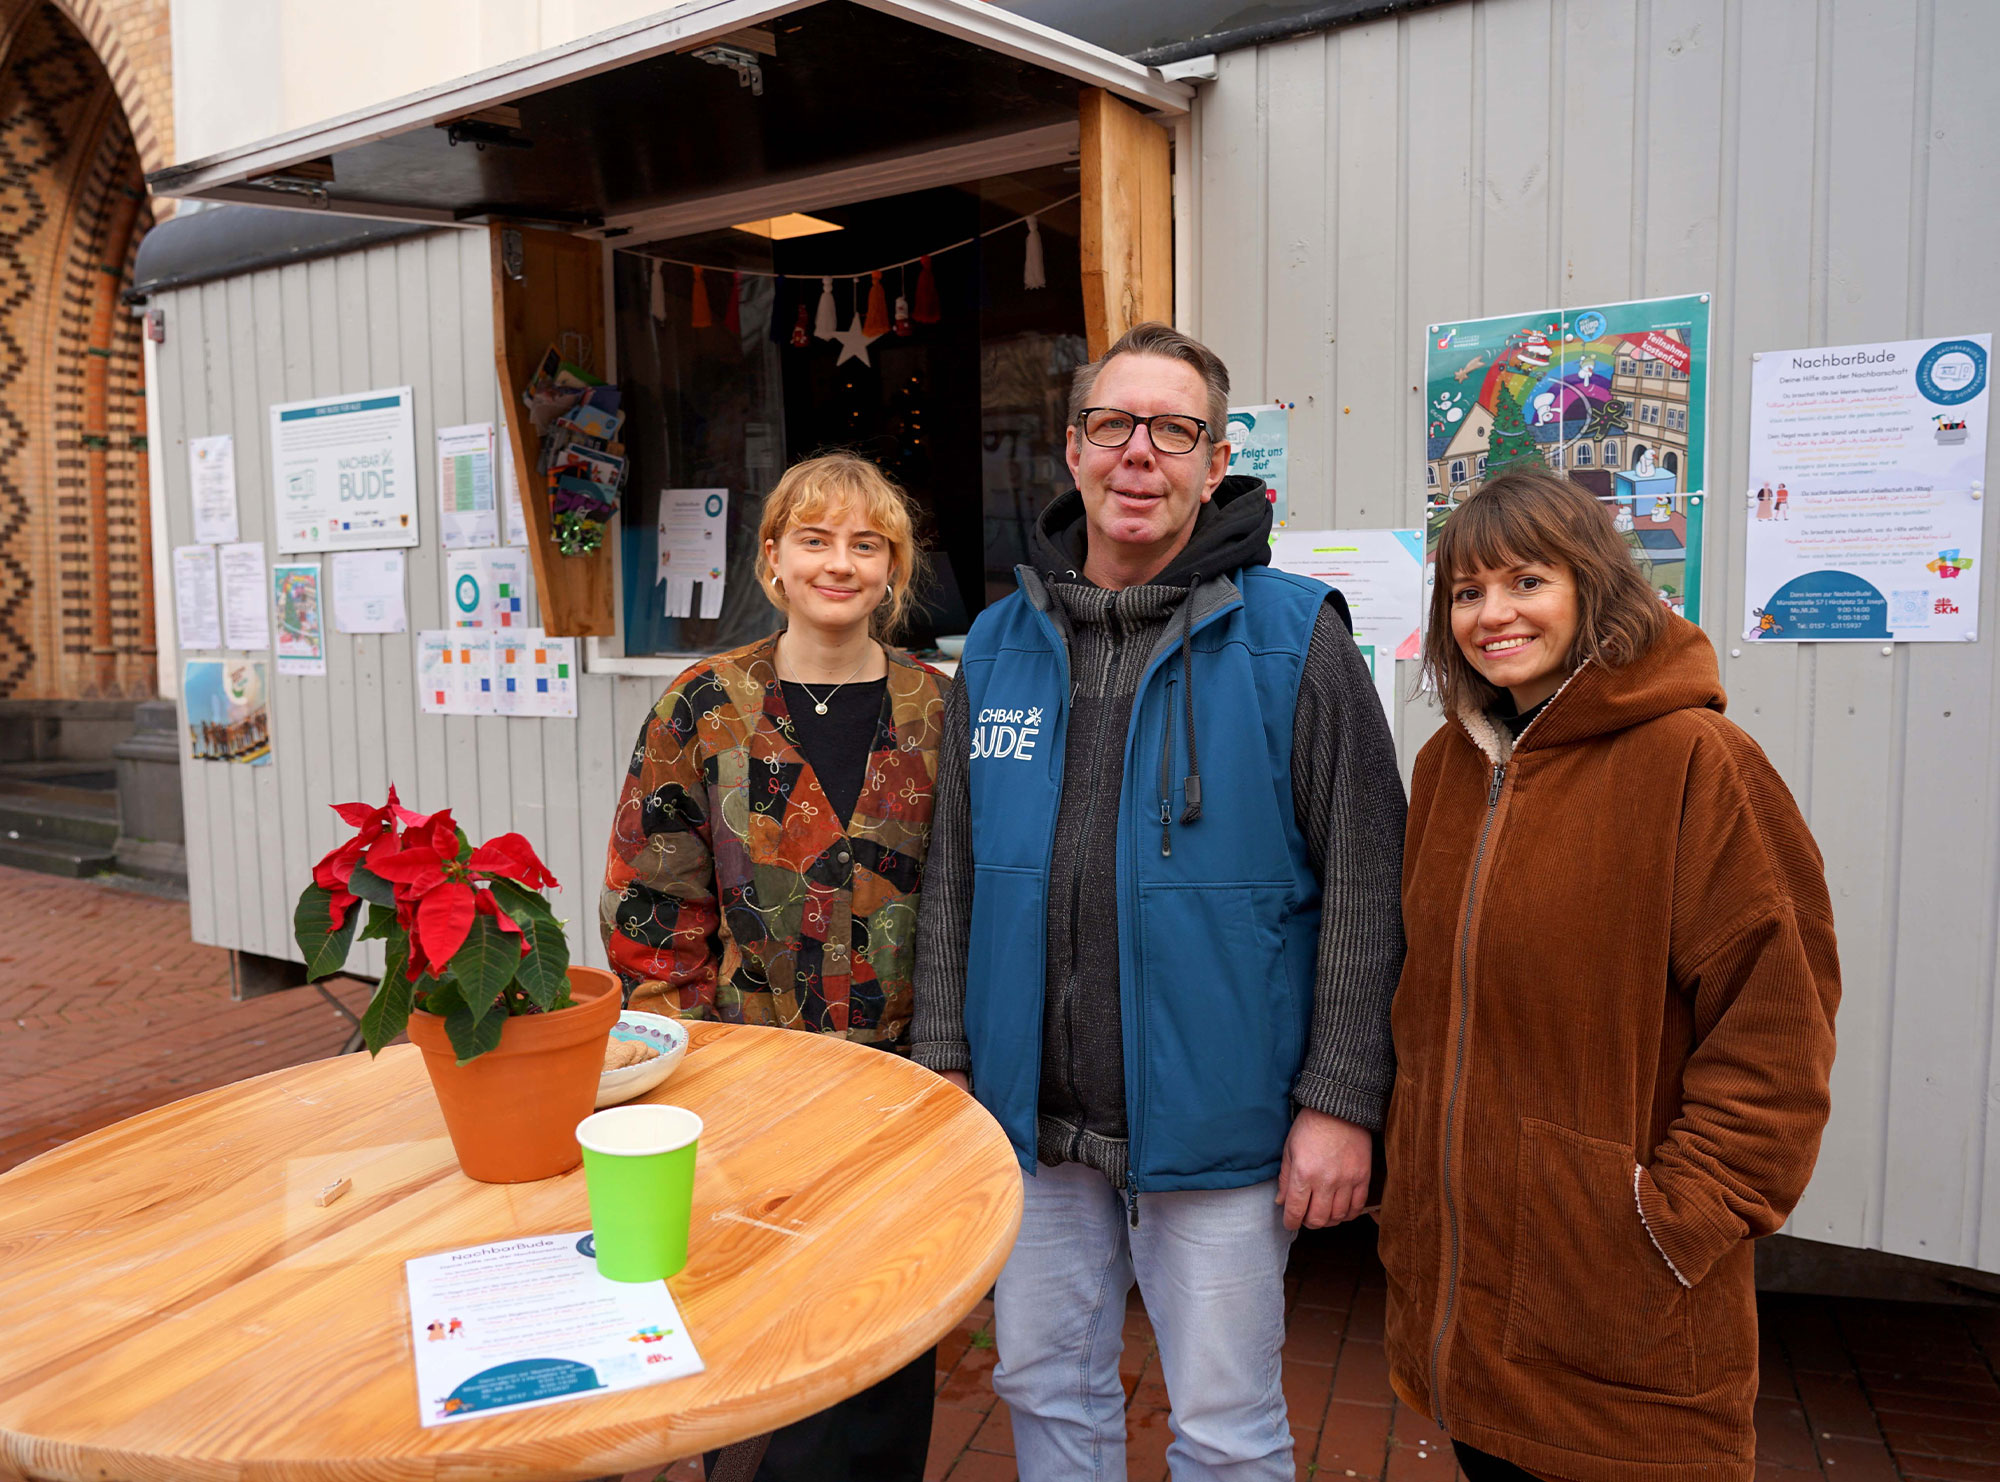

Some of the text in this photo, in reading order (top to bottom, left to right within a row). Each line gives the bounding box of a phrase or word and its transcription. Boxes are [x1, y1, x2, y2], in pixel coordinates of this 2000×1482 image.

[1641, 341, 1683, 368] kostenfrei
[1648, 332, 1688, 360] Teilnahme
[1792, 350, 1895, 369] NachbarBude
[1852, 368, 1908, 378] Nachbarschaft
[338, 455, 379, 469] NACHBAR
[1242, 448, 1283, 461] Folgt uns
[1253, 459, 1270, 470] auf
[340, 469, 395, 501] BUDE
[970, 726, 1039, 760] BUDE
[452, 1240, 554, 1260] NachbarBude
